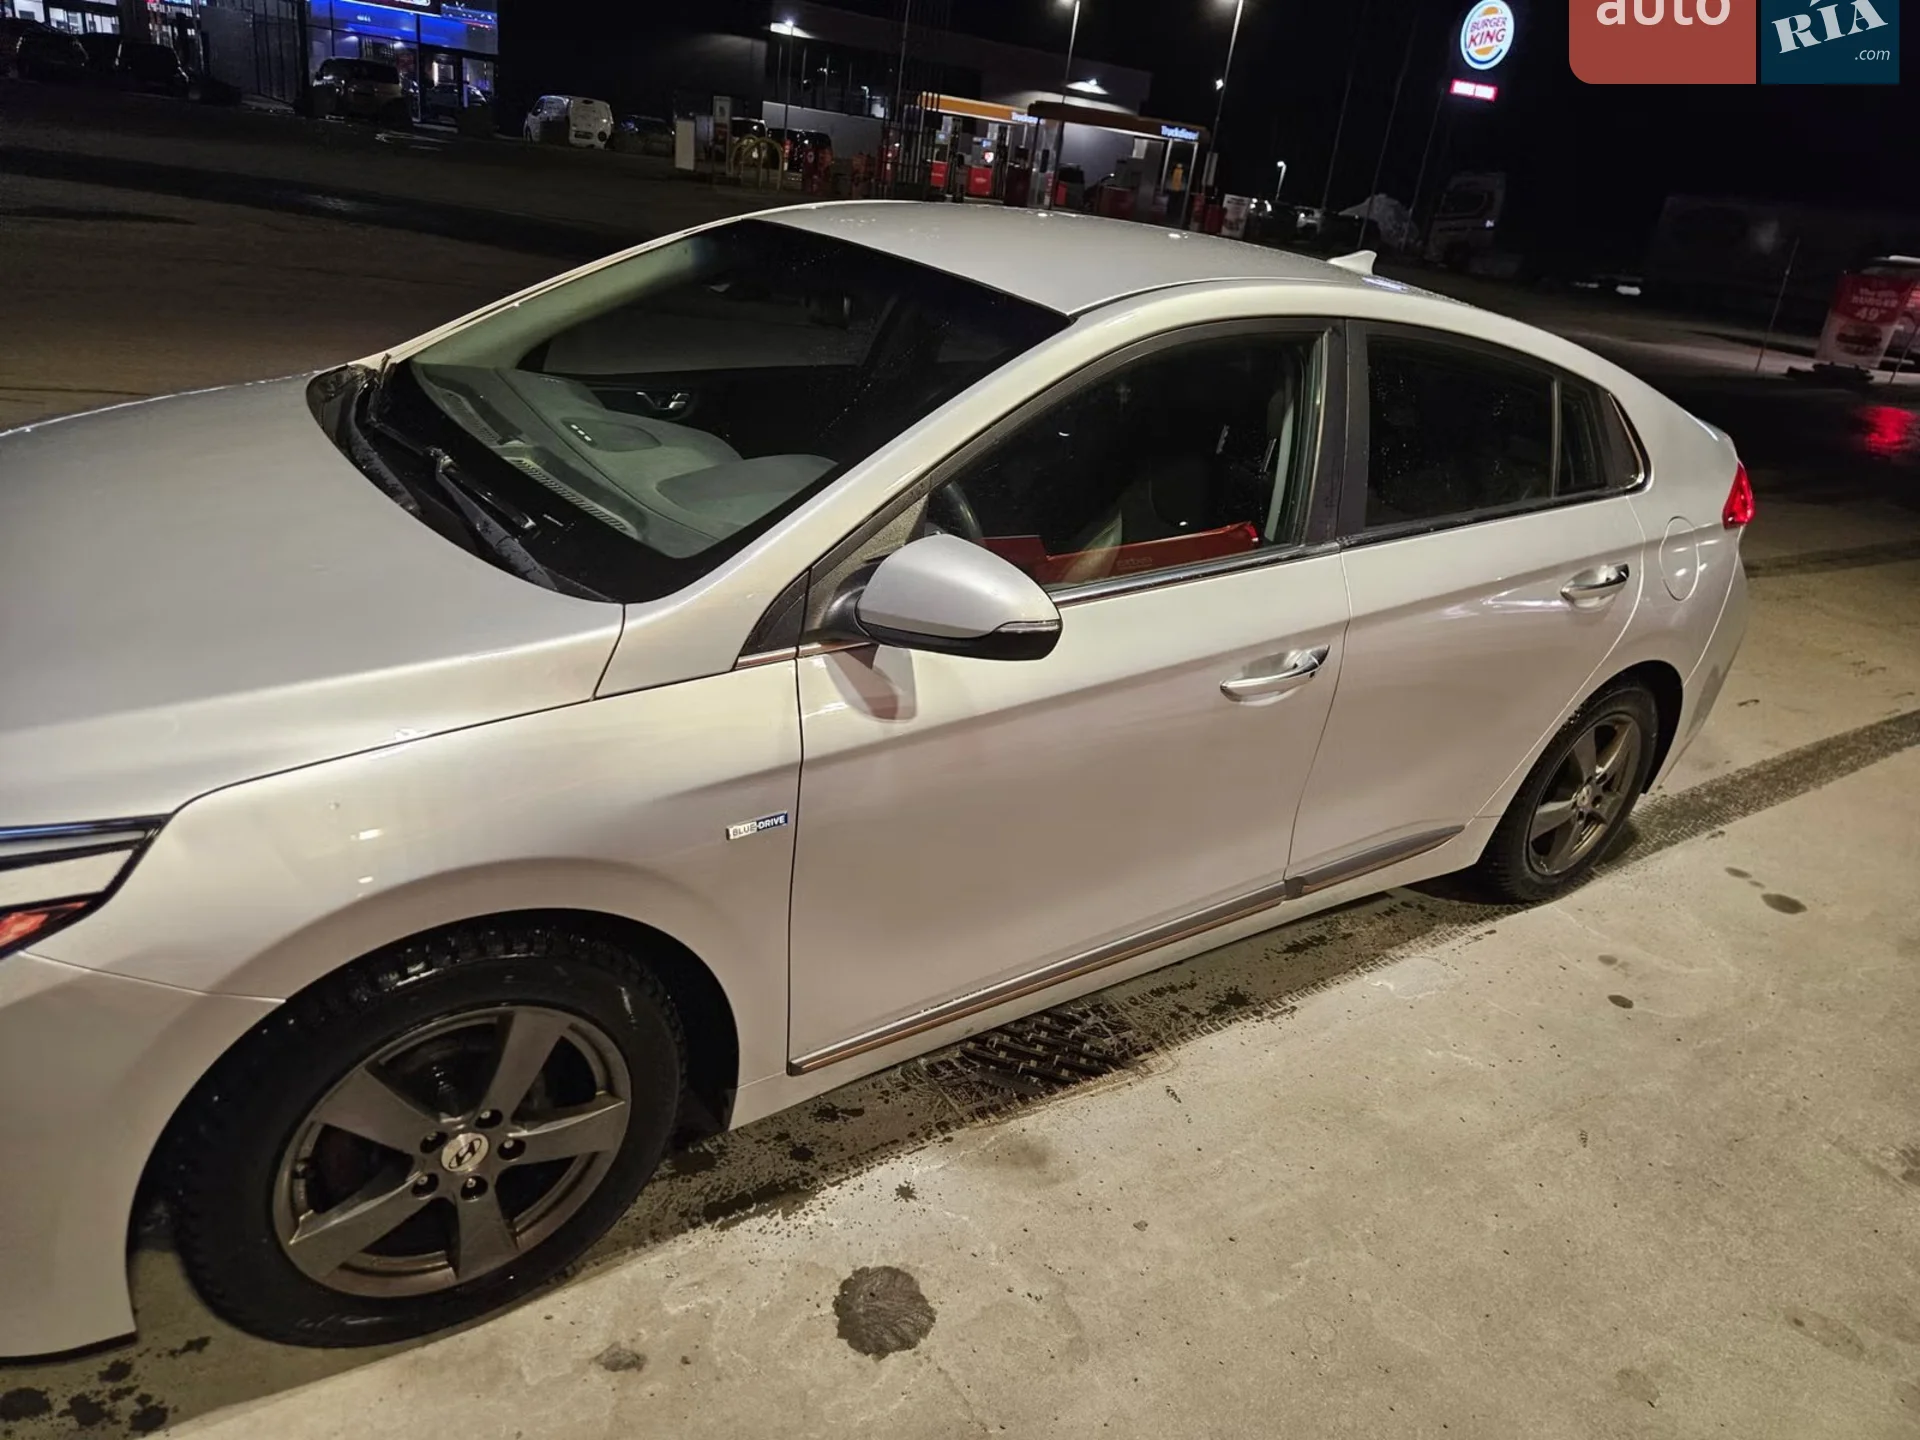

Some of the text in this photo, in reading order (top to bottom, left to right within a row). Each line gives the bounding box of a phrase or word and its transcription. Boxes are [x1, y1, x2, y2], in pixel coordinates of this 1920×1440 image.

[1470, 17, 1508, 33] BURGER
[1467, 28, 1507, 49] KING
[732, 815, 785, 836] BLUE DRIVE
